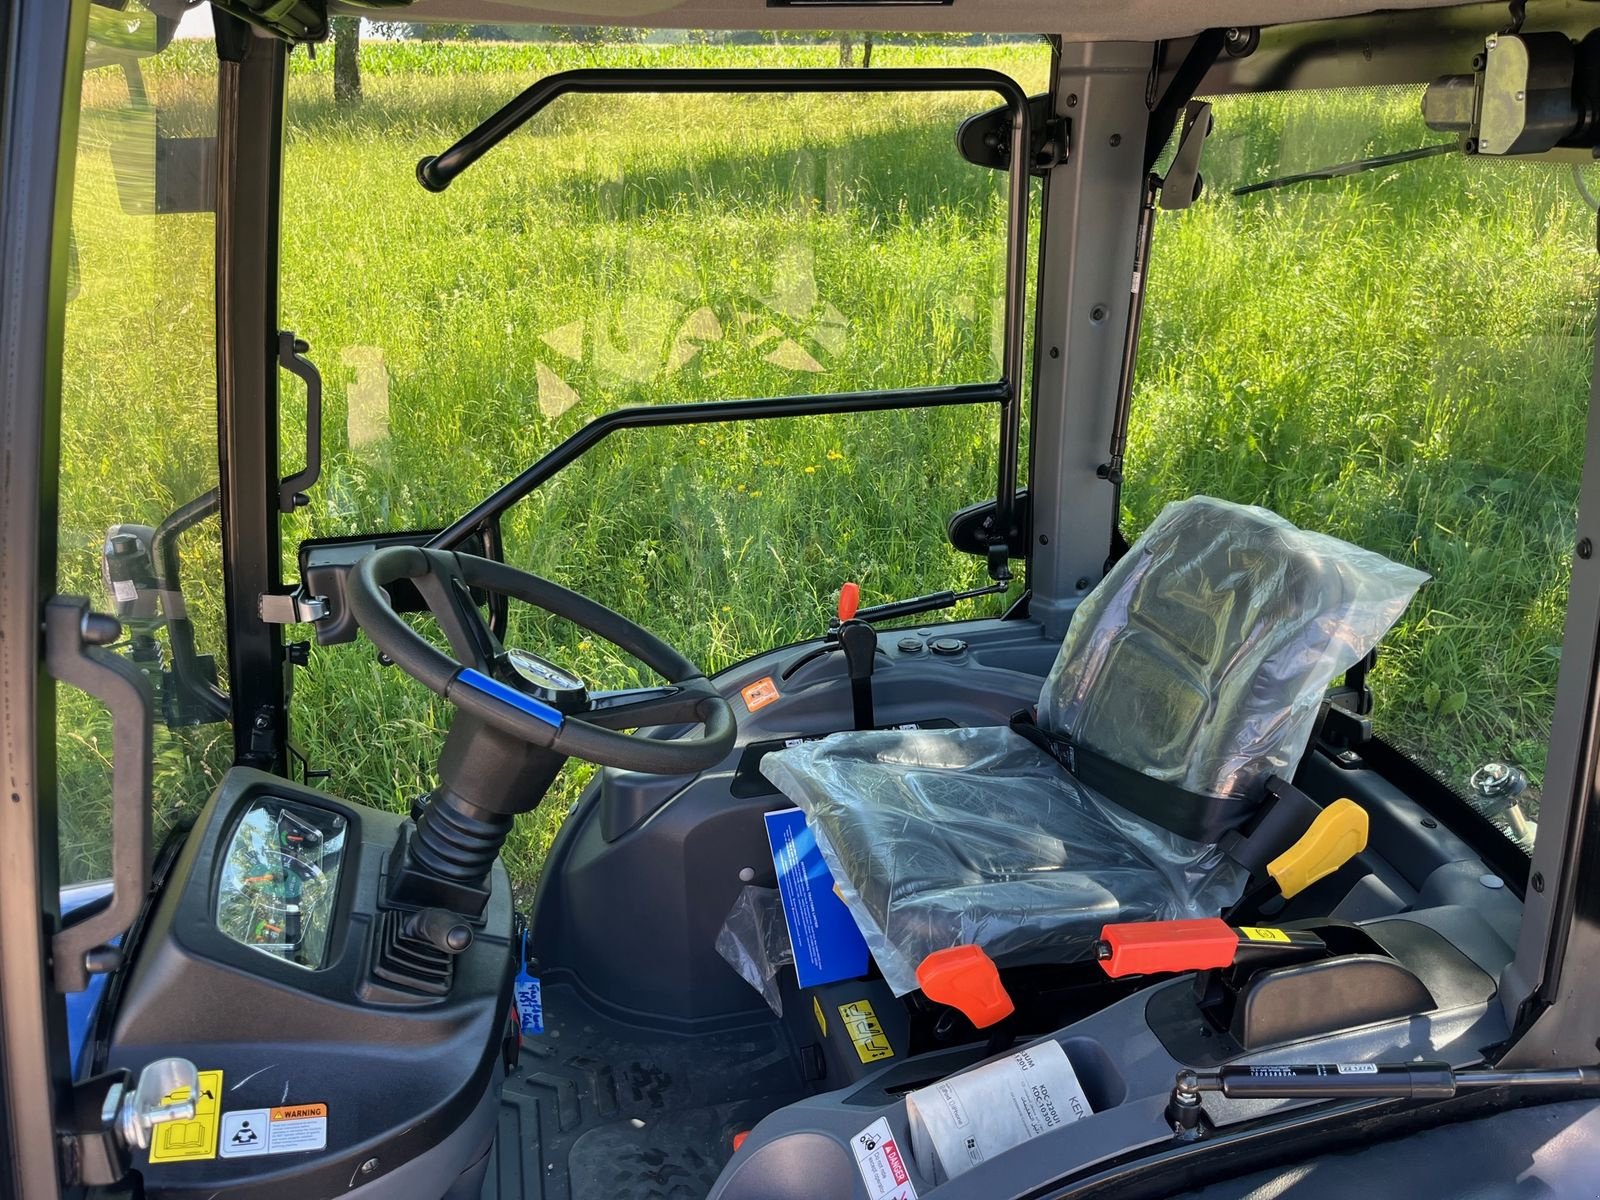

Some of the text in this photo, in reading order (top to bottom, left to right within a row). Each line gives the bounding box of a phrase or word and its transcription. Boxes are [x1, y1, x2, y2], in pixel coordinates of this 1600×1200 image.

[284, 1108, 321, 1118] WARNING
[1031, 1086, 1054, 1127] KDC-1030U
[1039, 1084, 1061, 1124] KDC-220UI
[888, 1152, 905, 1182] DANGER
